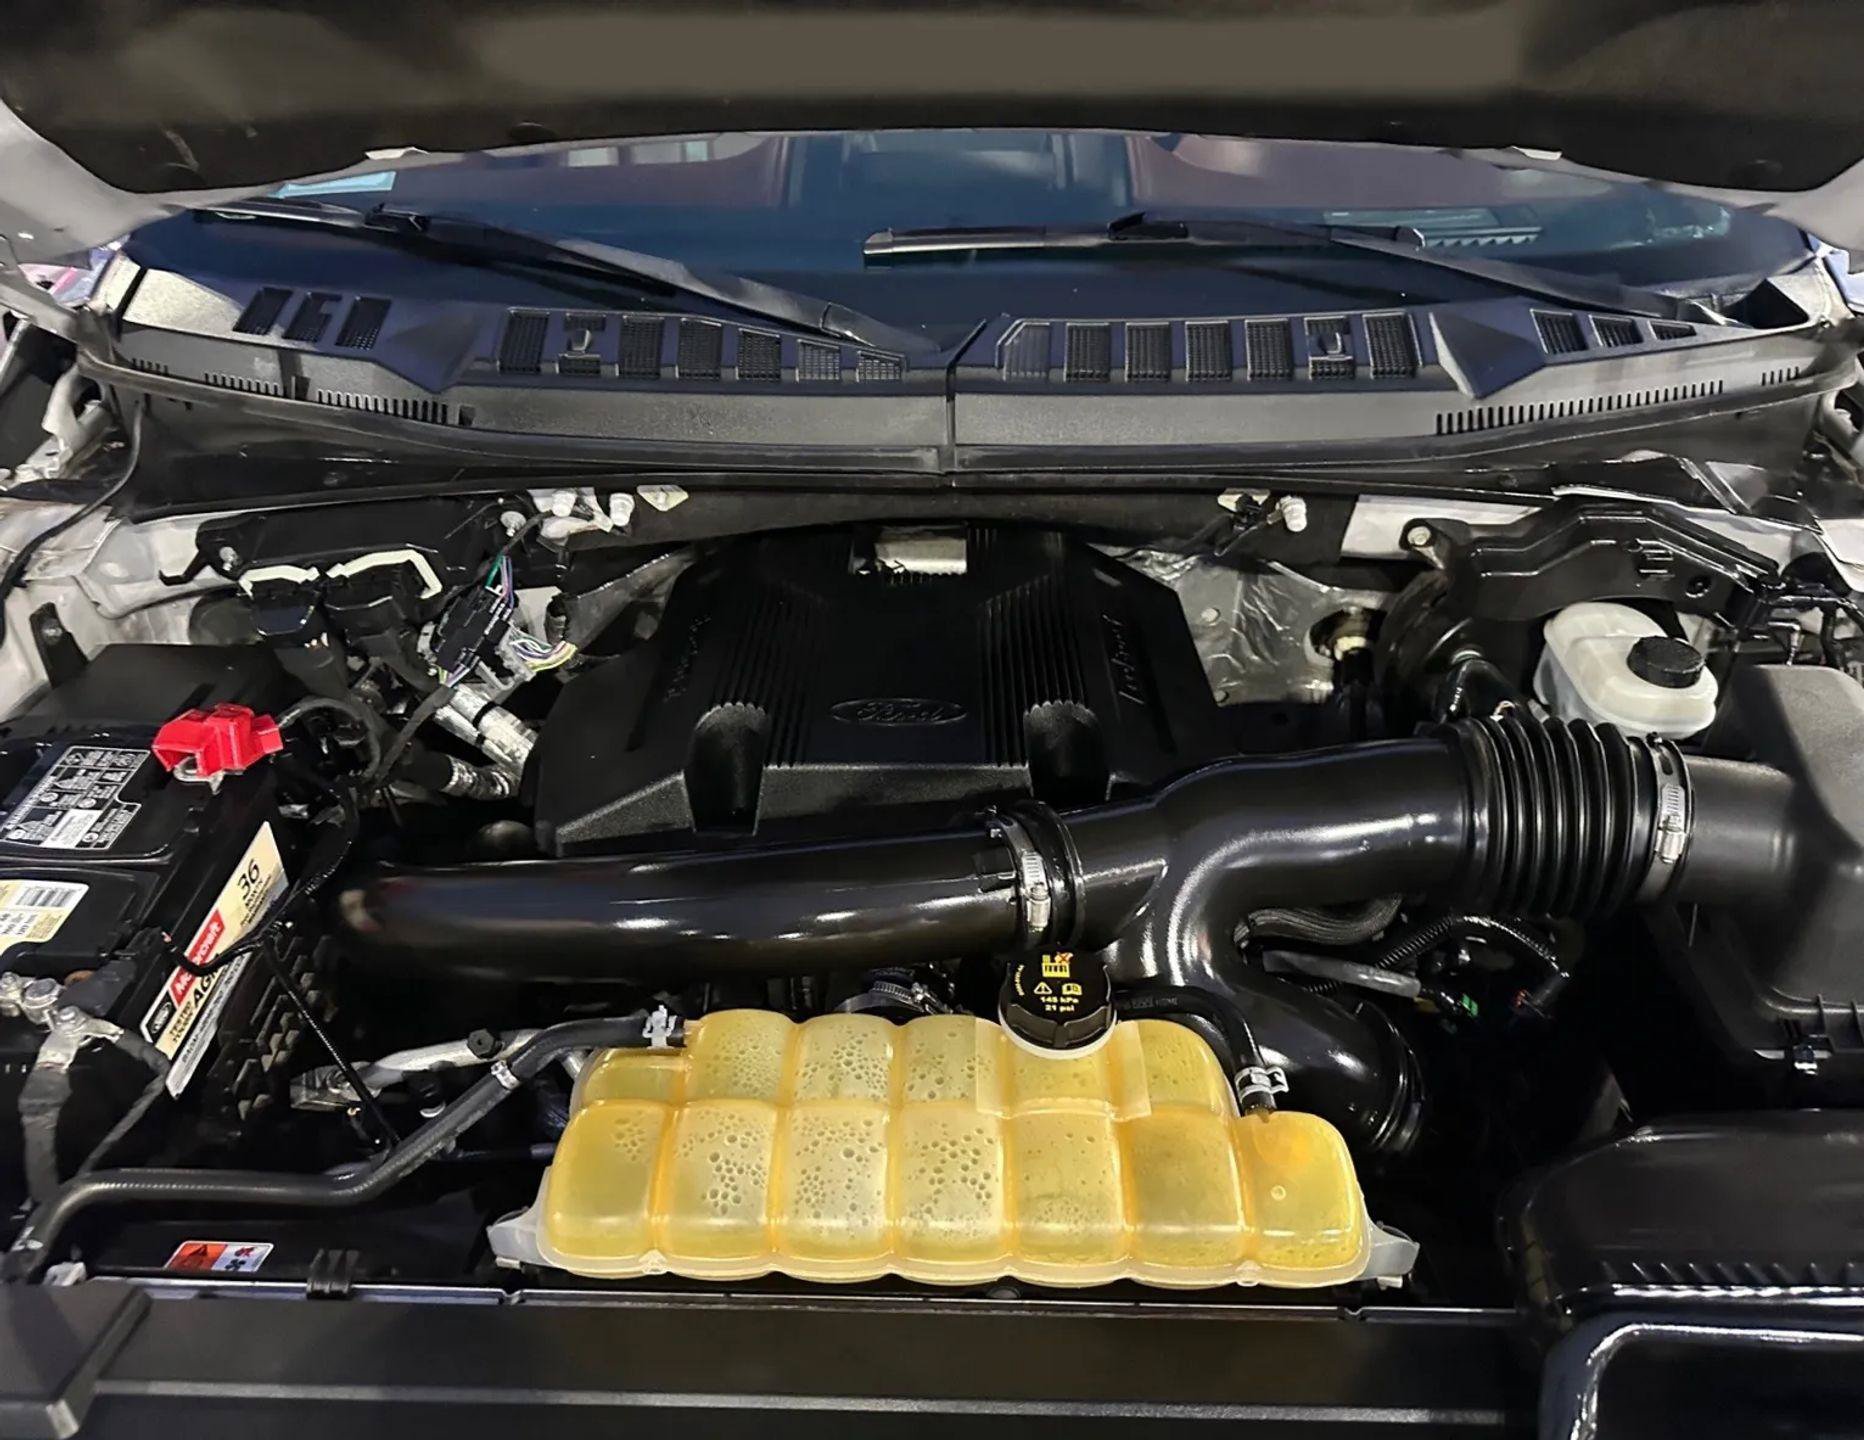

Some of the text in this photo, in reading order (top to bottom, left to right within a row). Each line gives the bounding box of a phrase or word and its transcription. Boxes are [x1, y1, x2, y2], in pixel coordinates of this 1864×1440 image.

[238, 858, 260, 900] 36
[174, 920, 221, 996] Moorcraft
[1045, 1004, 1057, 1012] 21
